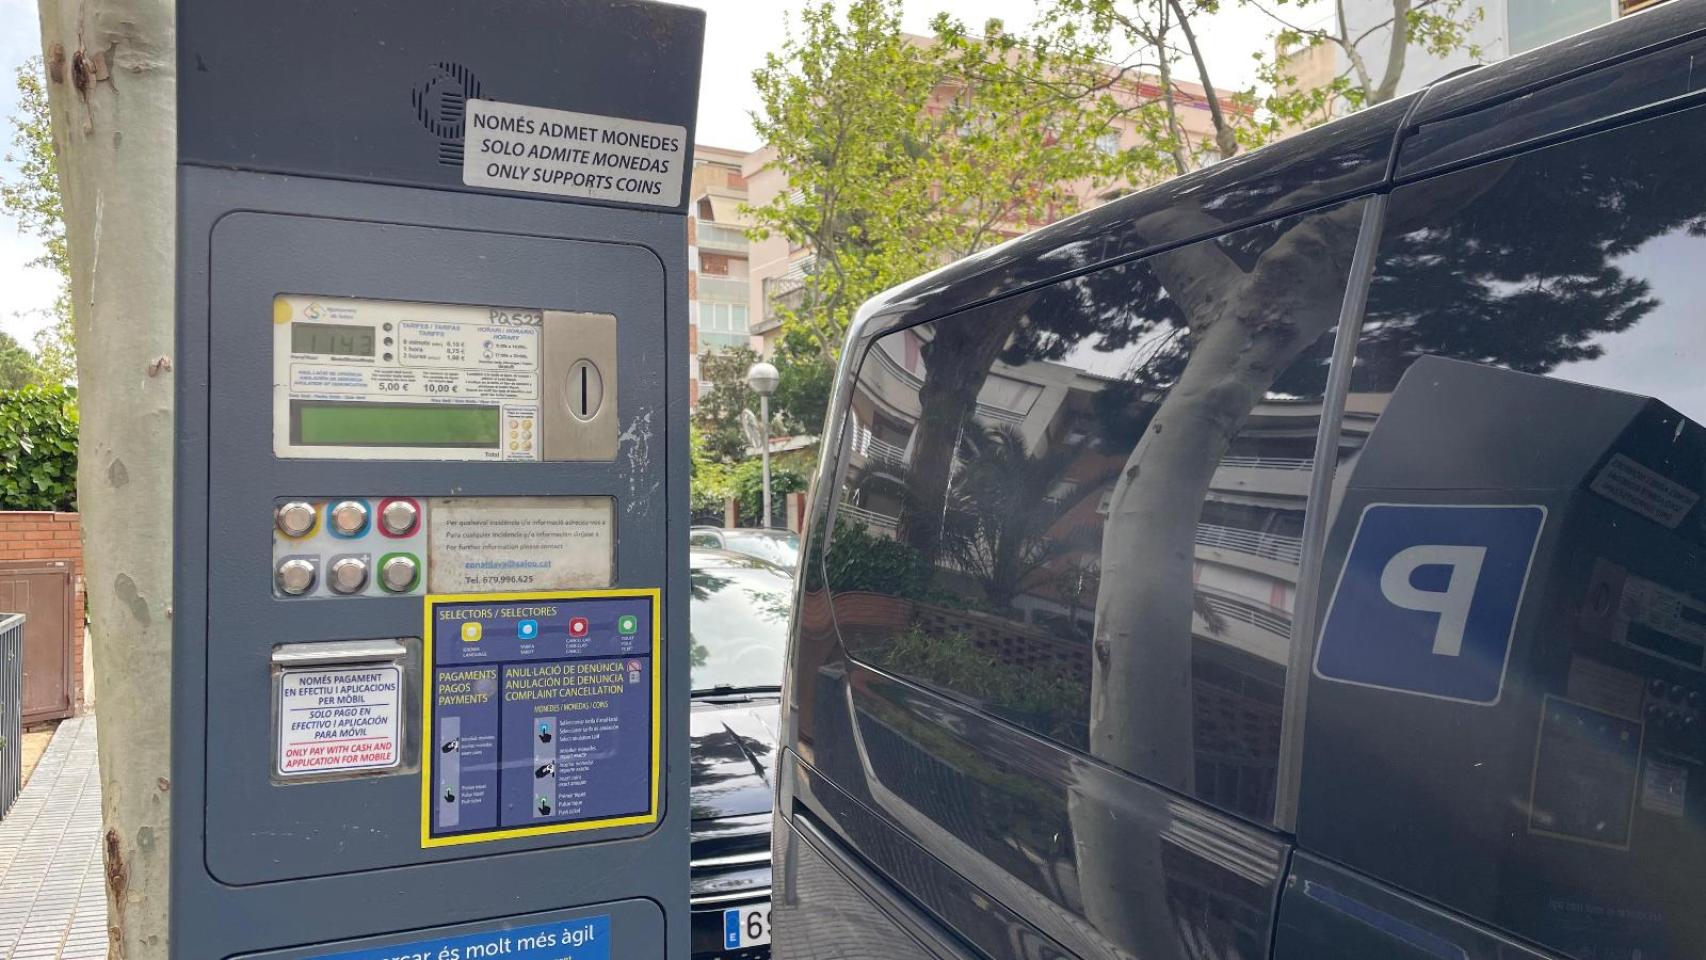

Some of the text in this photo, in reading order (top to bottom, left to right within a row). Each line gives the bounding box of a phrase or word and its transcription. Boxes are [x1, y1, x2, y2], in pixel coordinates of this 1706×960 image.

[473, 113, 679, 153] NOMÉS ADMET MONEDES
[481, 138, 669, 174] SOLO ADMITE MONEDAS
[486, 163, 662, 195] ONLY SUPPORTS COINS
[378, 382, 409, 392] 5,00 €
[424, 384, 458, 394] 10,00 €
[439, 608, 493, 620] SELECTORS
[500, 606, 558, 618] SELECTORES
[439, 669, 497, 681] PAGAMENTS
[563, 664, 576, 675] DE
[299, 673, 382, 685] NOMÉS PAGAMENT
[505, 676, 562, 690] ANULACIÓN
[563, 676, 576, 687] DE
[284, 688, 296, 697] EN
[299, 686, 333, 696] EFECTIU
[340, 682, 396, 693] APLICACIONS
[439, 683, 471, 693] PAGOS
[505, 685, 624, 702] COMPLAINT CANCELLATION
[318, 694, 365, 705] PER MÒBIL
[438, 694, 488, 706] PAYMENTS
[309, 707, 371, 719] SOLO PAGO EN
[291, 720, 332, 731] EFECTIVO
[338, 716, 388, 728] APLICACIÓN
[314, 727, 367, 739] PARA MÓVIL
[286, 741, 392, 758] ONLY PAY WITH CASH AND
[286, 751, 392, 768] APPLICATION FOR MOBILE
[438, 945, 460, 960] és
[466, 938, 512, 959] molt
[517, 931, 556, 951] més
[561, 924, 594, 947] àgil
[729, 932, 737, 942] E
